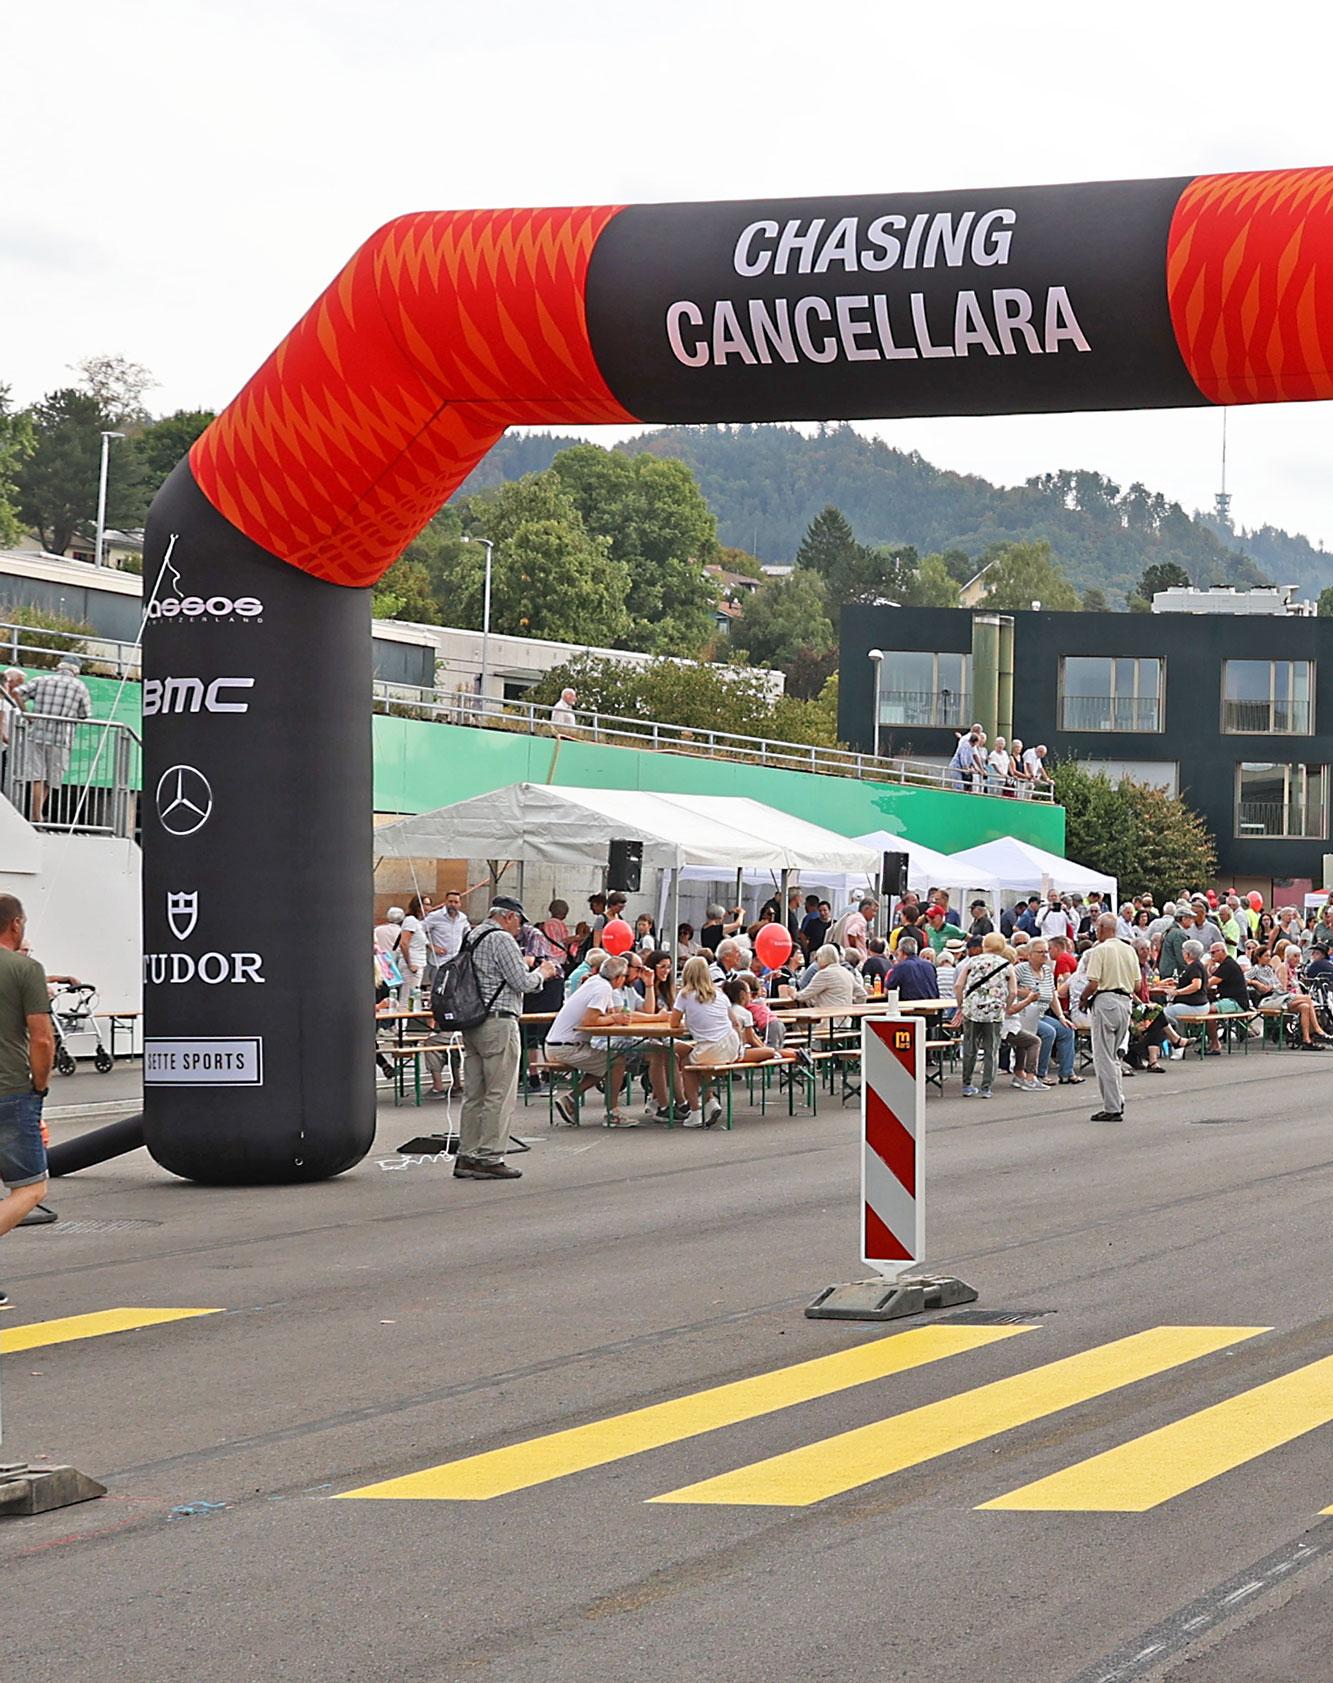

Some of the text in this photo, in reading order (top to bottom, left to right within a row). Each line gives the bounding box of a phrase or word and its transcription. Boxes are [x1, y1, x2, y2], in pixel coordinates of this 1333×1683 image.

[733, 208, 1016, 277] CHASING
[666, 286, 1091, 368] CANCELLARA
[142, 677, 255, 716] BMC
[183, 1053, 245, 1070] SPORTS
